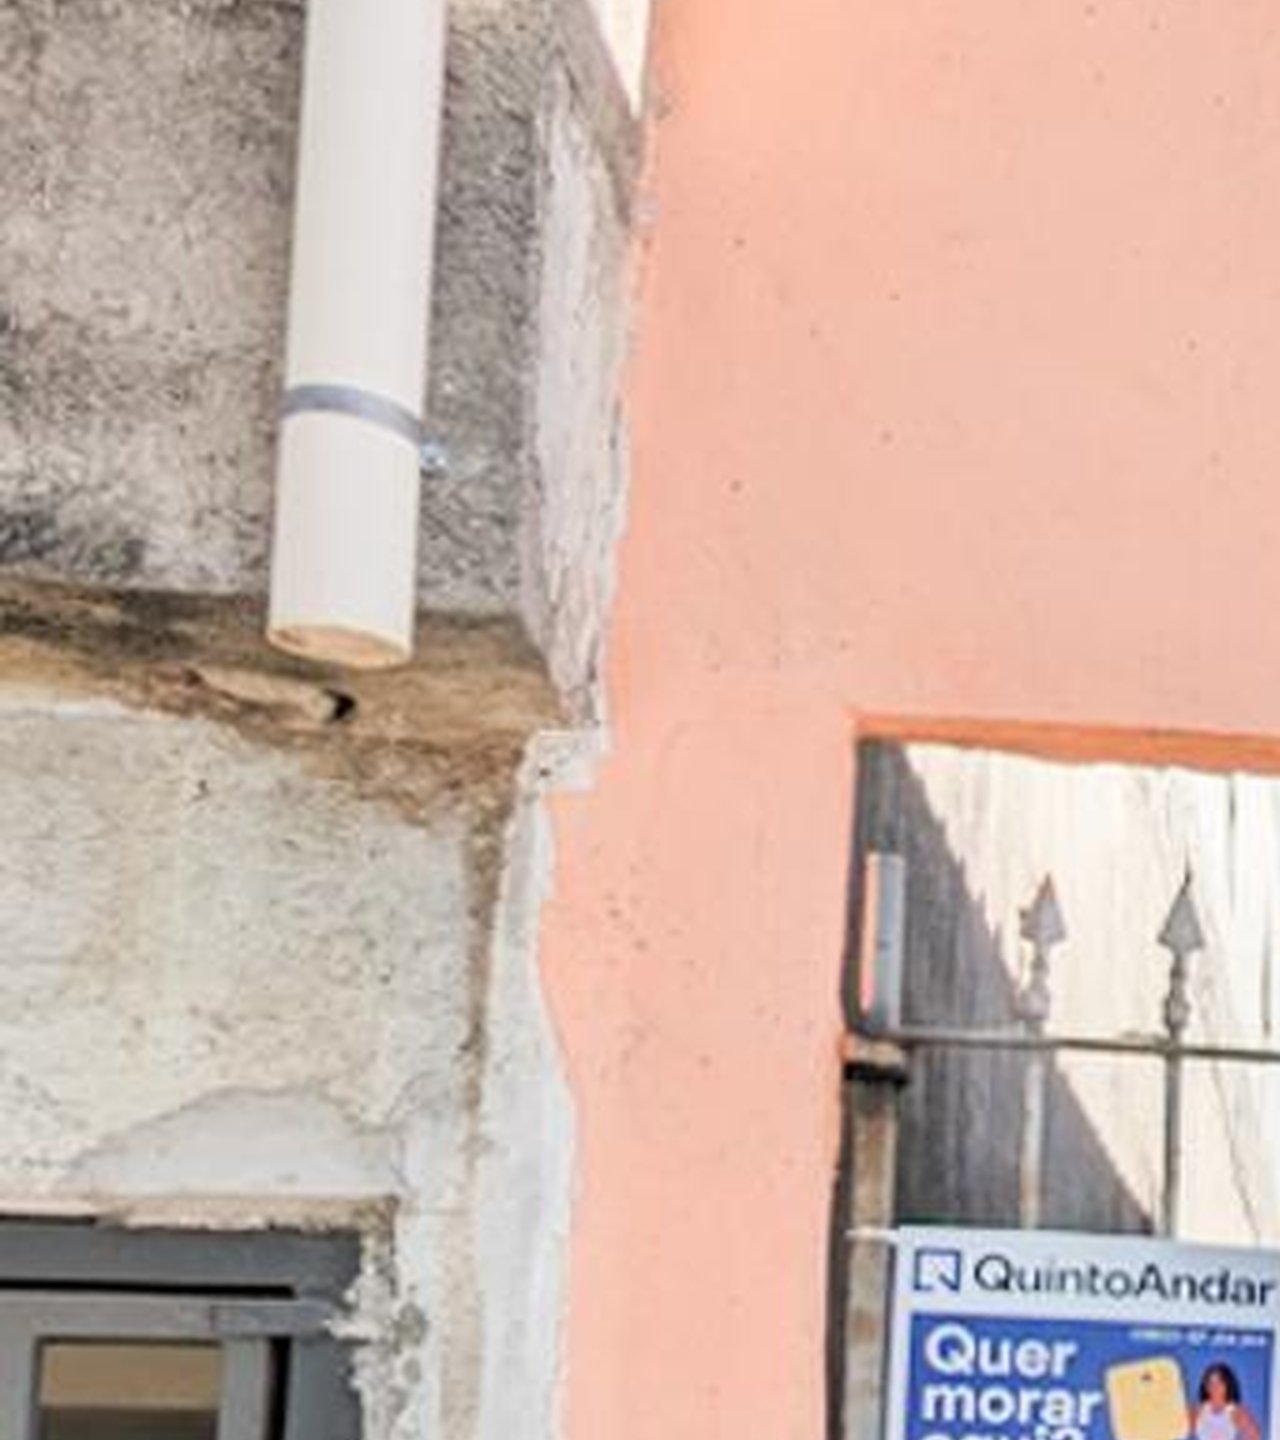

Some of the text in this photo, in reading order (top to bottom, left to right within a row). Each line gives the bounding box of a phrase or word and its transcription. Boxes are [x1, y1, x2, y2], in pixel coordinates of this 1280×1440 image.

[973, 1254, 1278, 1310] QuintoAndar
[924, 1324, 1078, 1380] Quer
[921, 1384, 1104, 1428] morar
